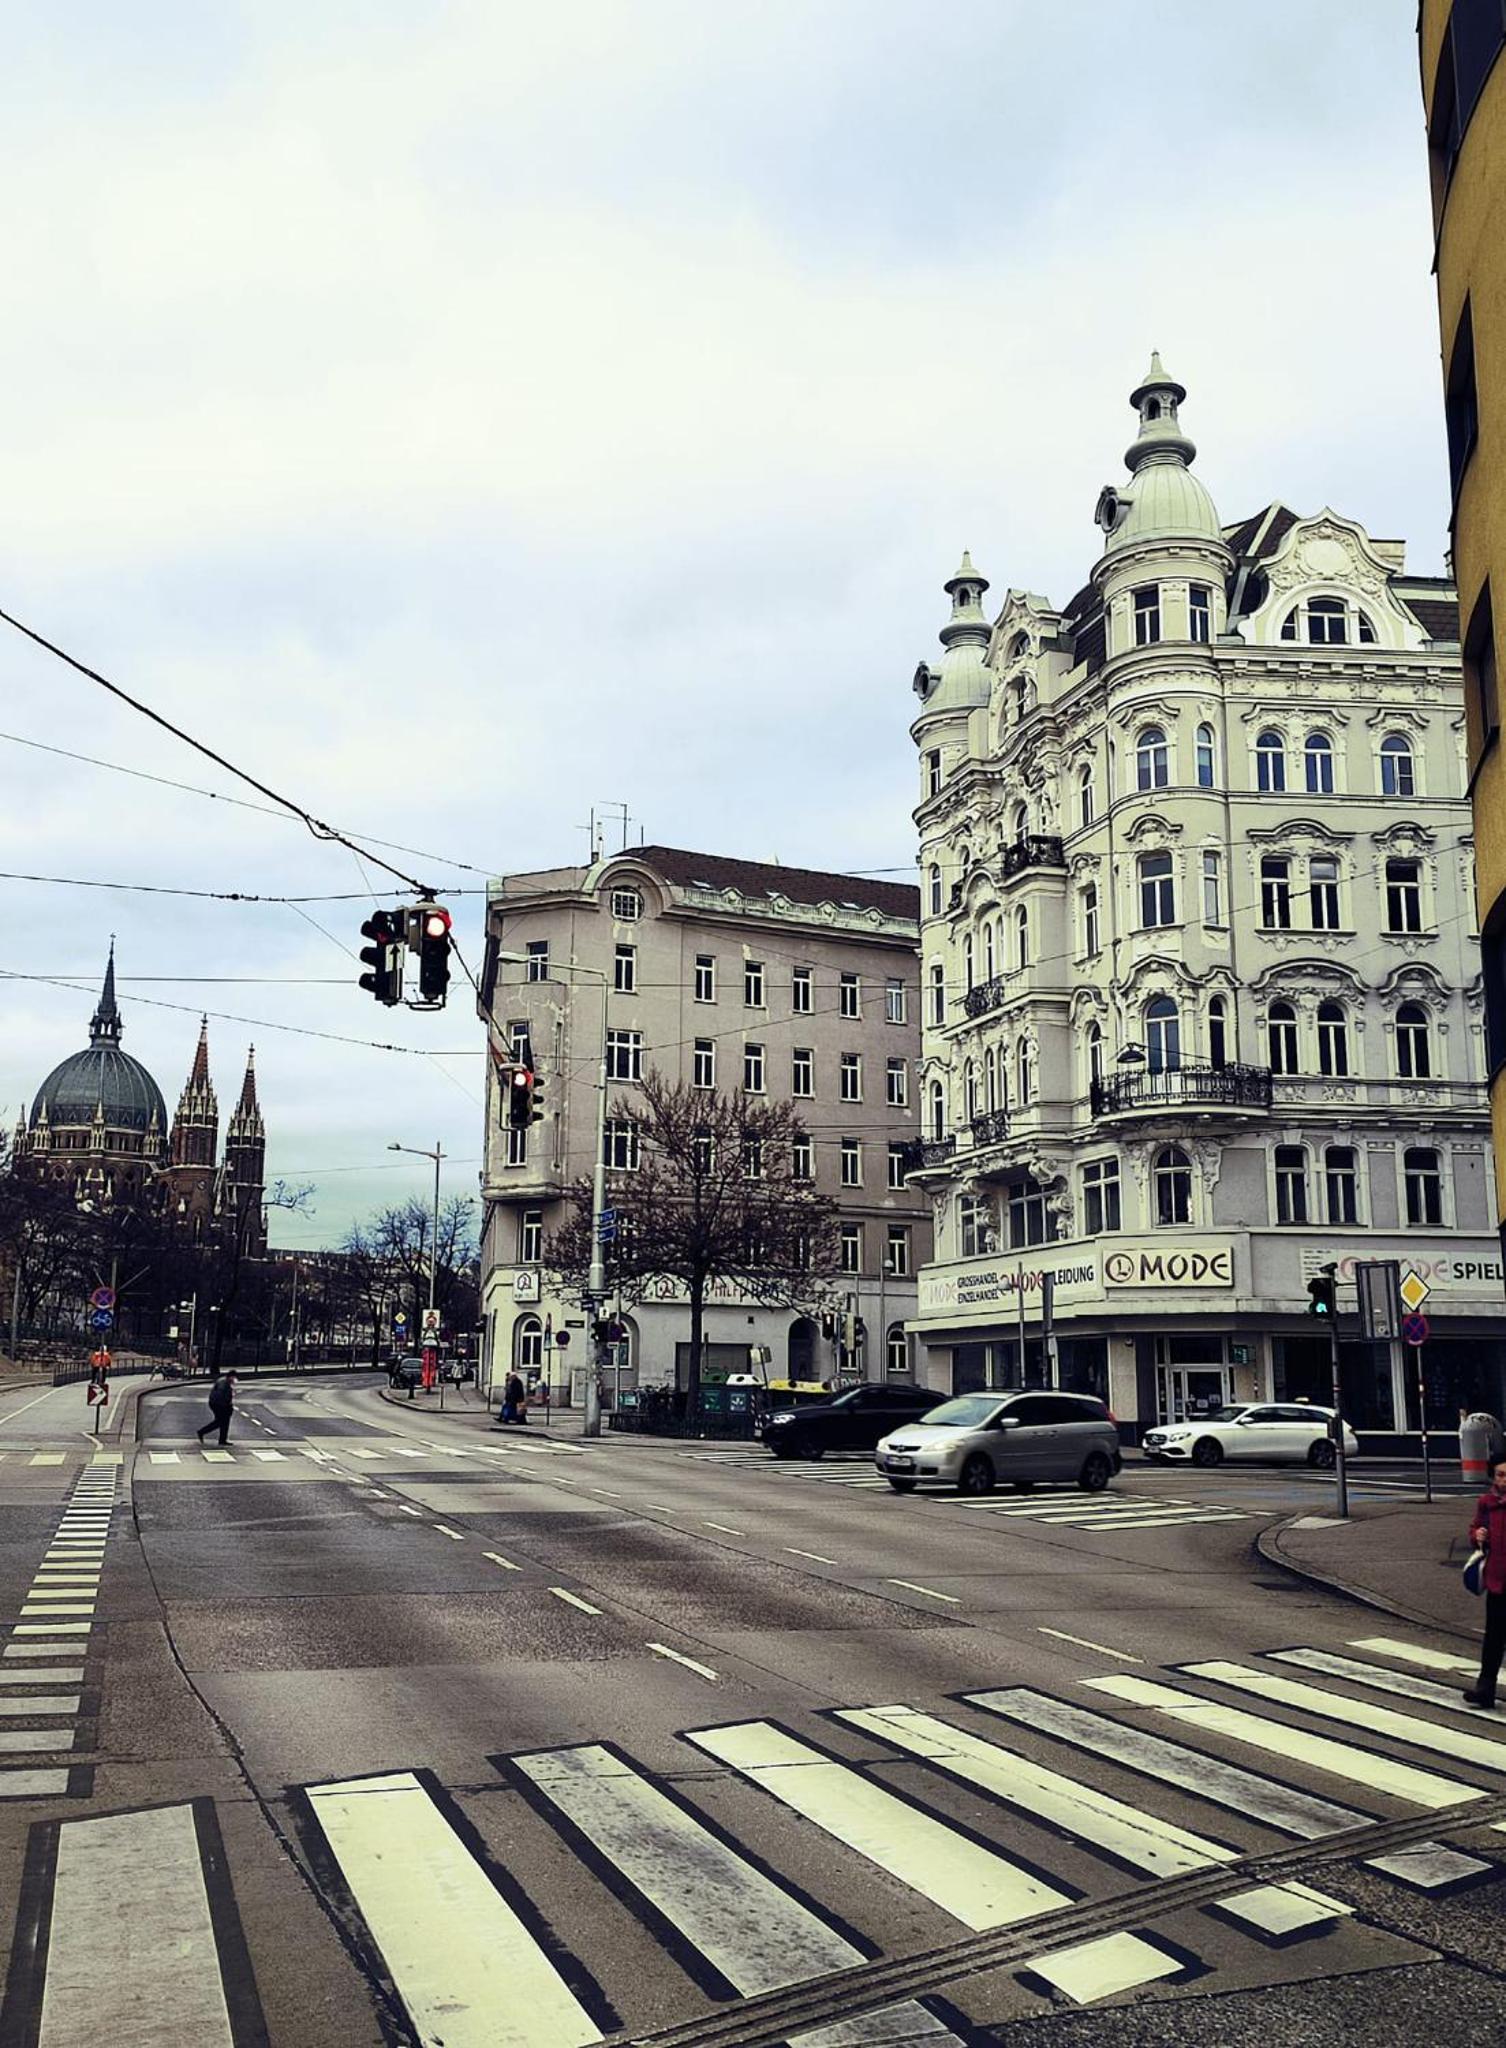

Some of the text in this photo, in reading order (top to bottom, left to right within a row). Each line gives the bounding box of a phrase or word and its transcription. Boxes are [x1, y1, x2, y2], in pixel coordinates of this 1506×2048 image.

[1052, 1264, 1094, 1286] LEIDUNG
[1140, 1253, 1230, 1281] MODE
[957, 1272, 999, 1289] GROSSHANDEL
